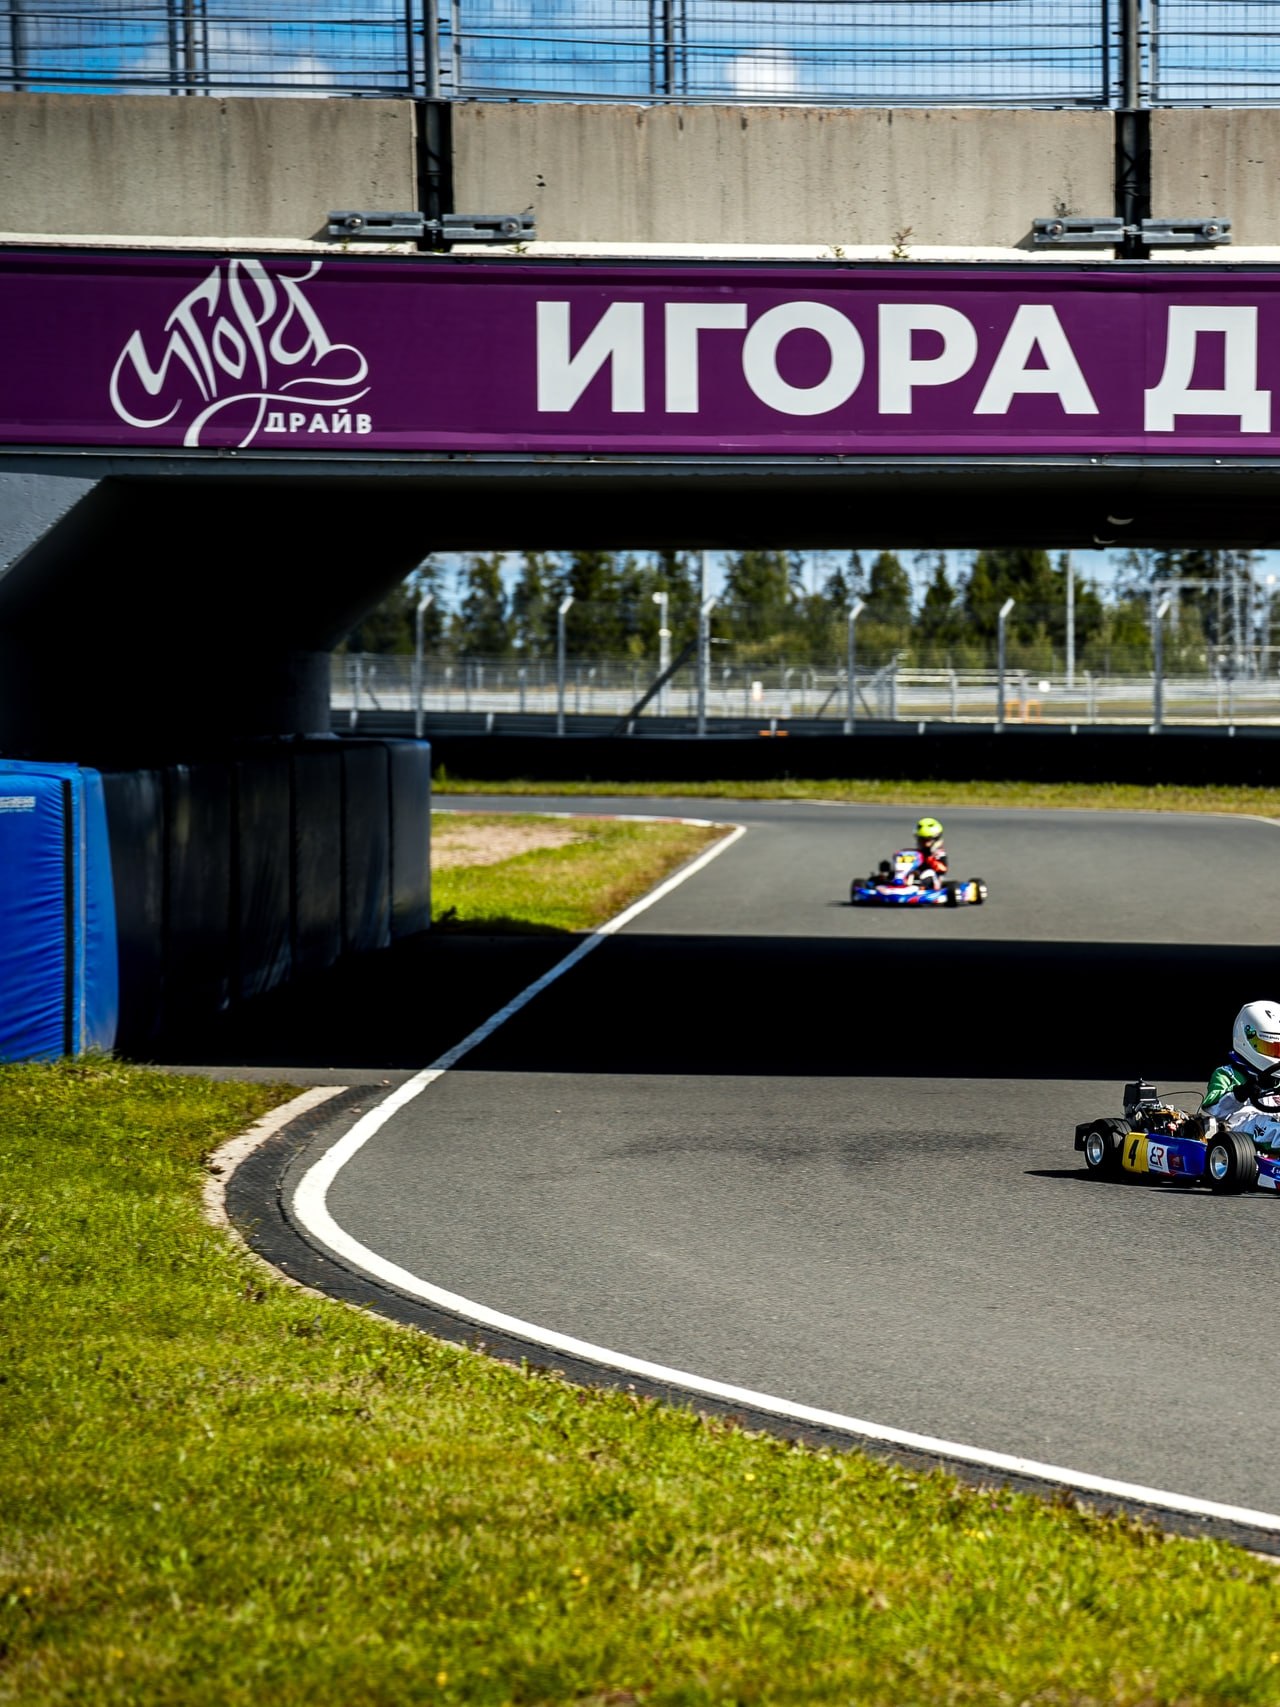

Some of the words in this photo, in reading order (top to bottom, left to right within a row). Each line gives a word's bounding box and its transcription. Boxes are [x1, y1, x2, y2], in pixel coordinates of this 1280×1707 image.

[536, 300, 1101, 416] ИГОРА
[263, 408, 373, 434] ДРАЙВ
[1128, 1139, 1140, 1168] 4
